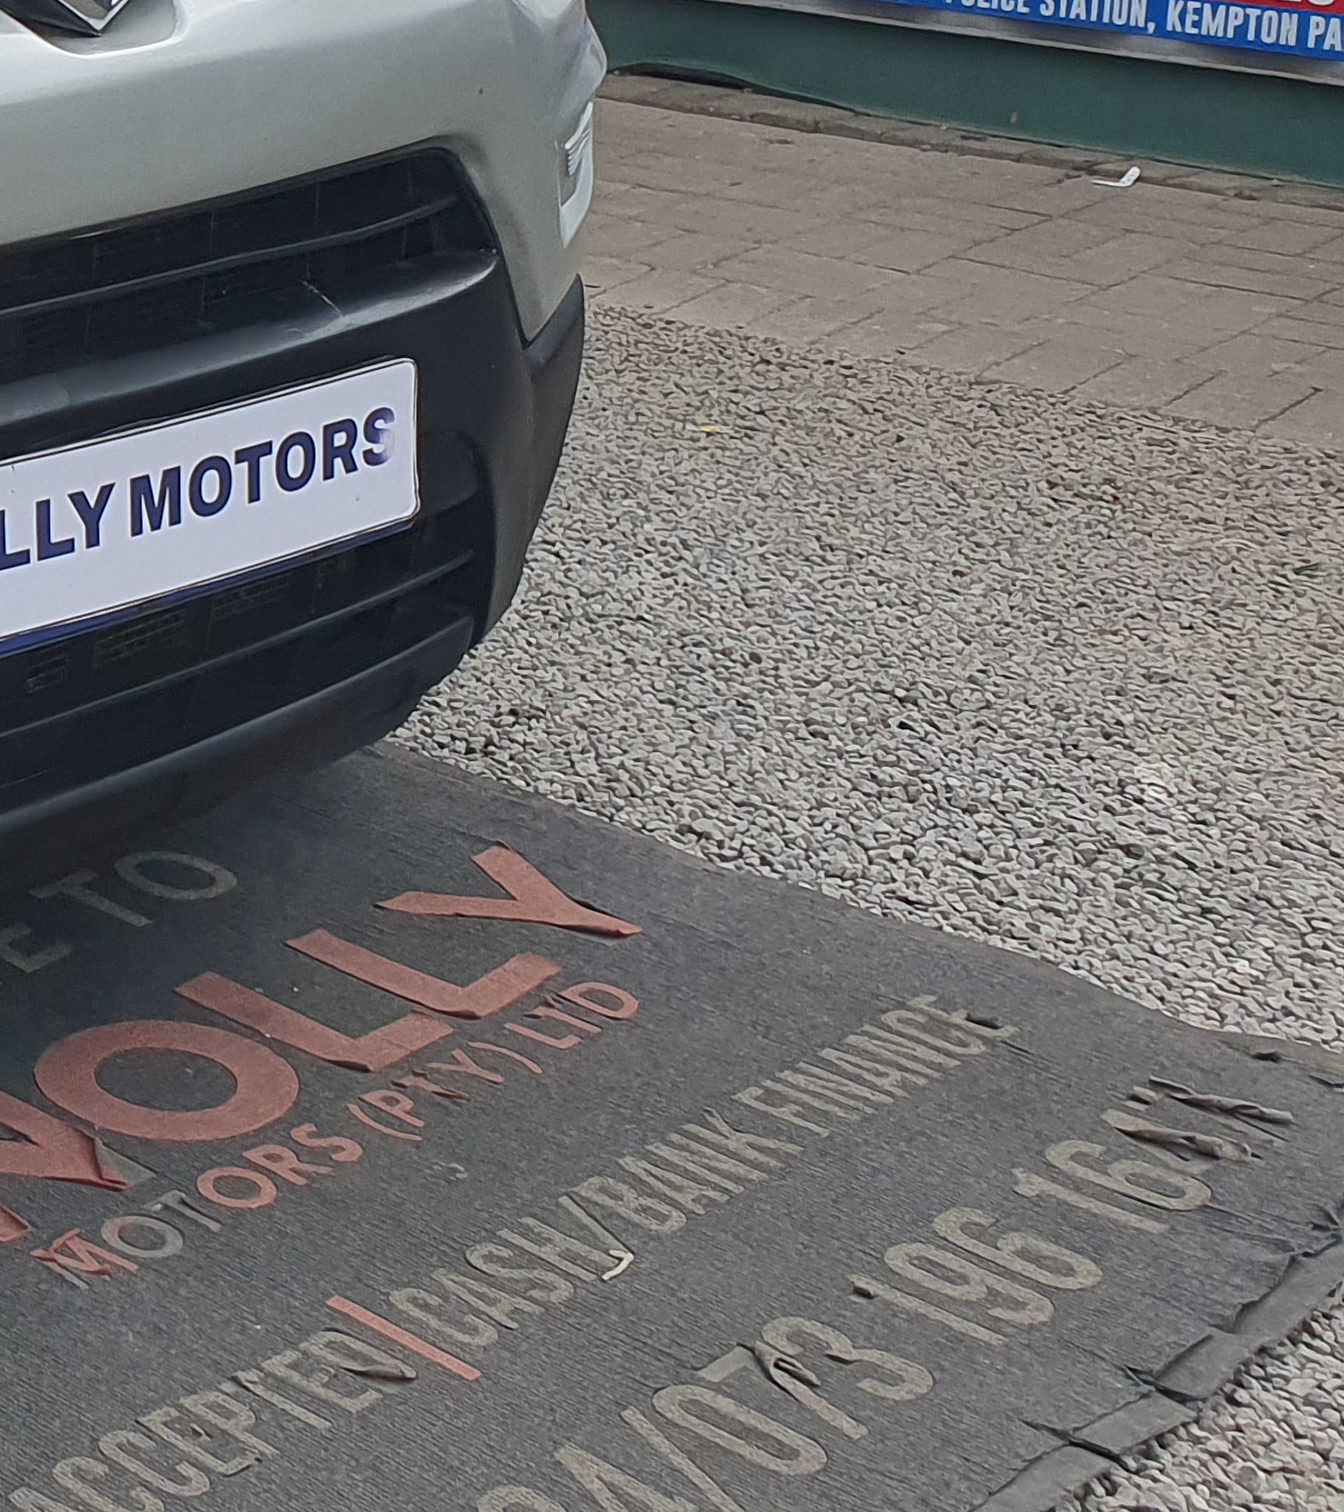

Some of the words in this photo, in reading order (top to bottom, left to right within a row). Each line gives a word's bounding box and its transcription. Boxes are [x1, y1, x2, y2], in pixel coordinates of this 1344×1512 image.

[128, 406, 396, 538] MOTORS
[28, 850, 240, 929] TO
[31, 1122, 364, 1289] MOTORS
[503, 981, 640, 1051] LTD
[732, 994, 1015, 1138] FINANCE
[849, 1206, 1105, 1348] 196
